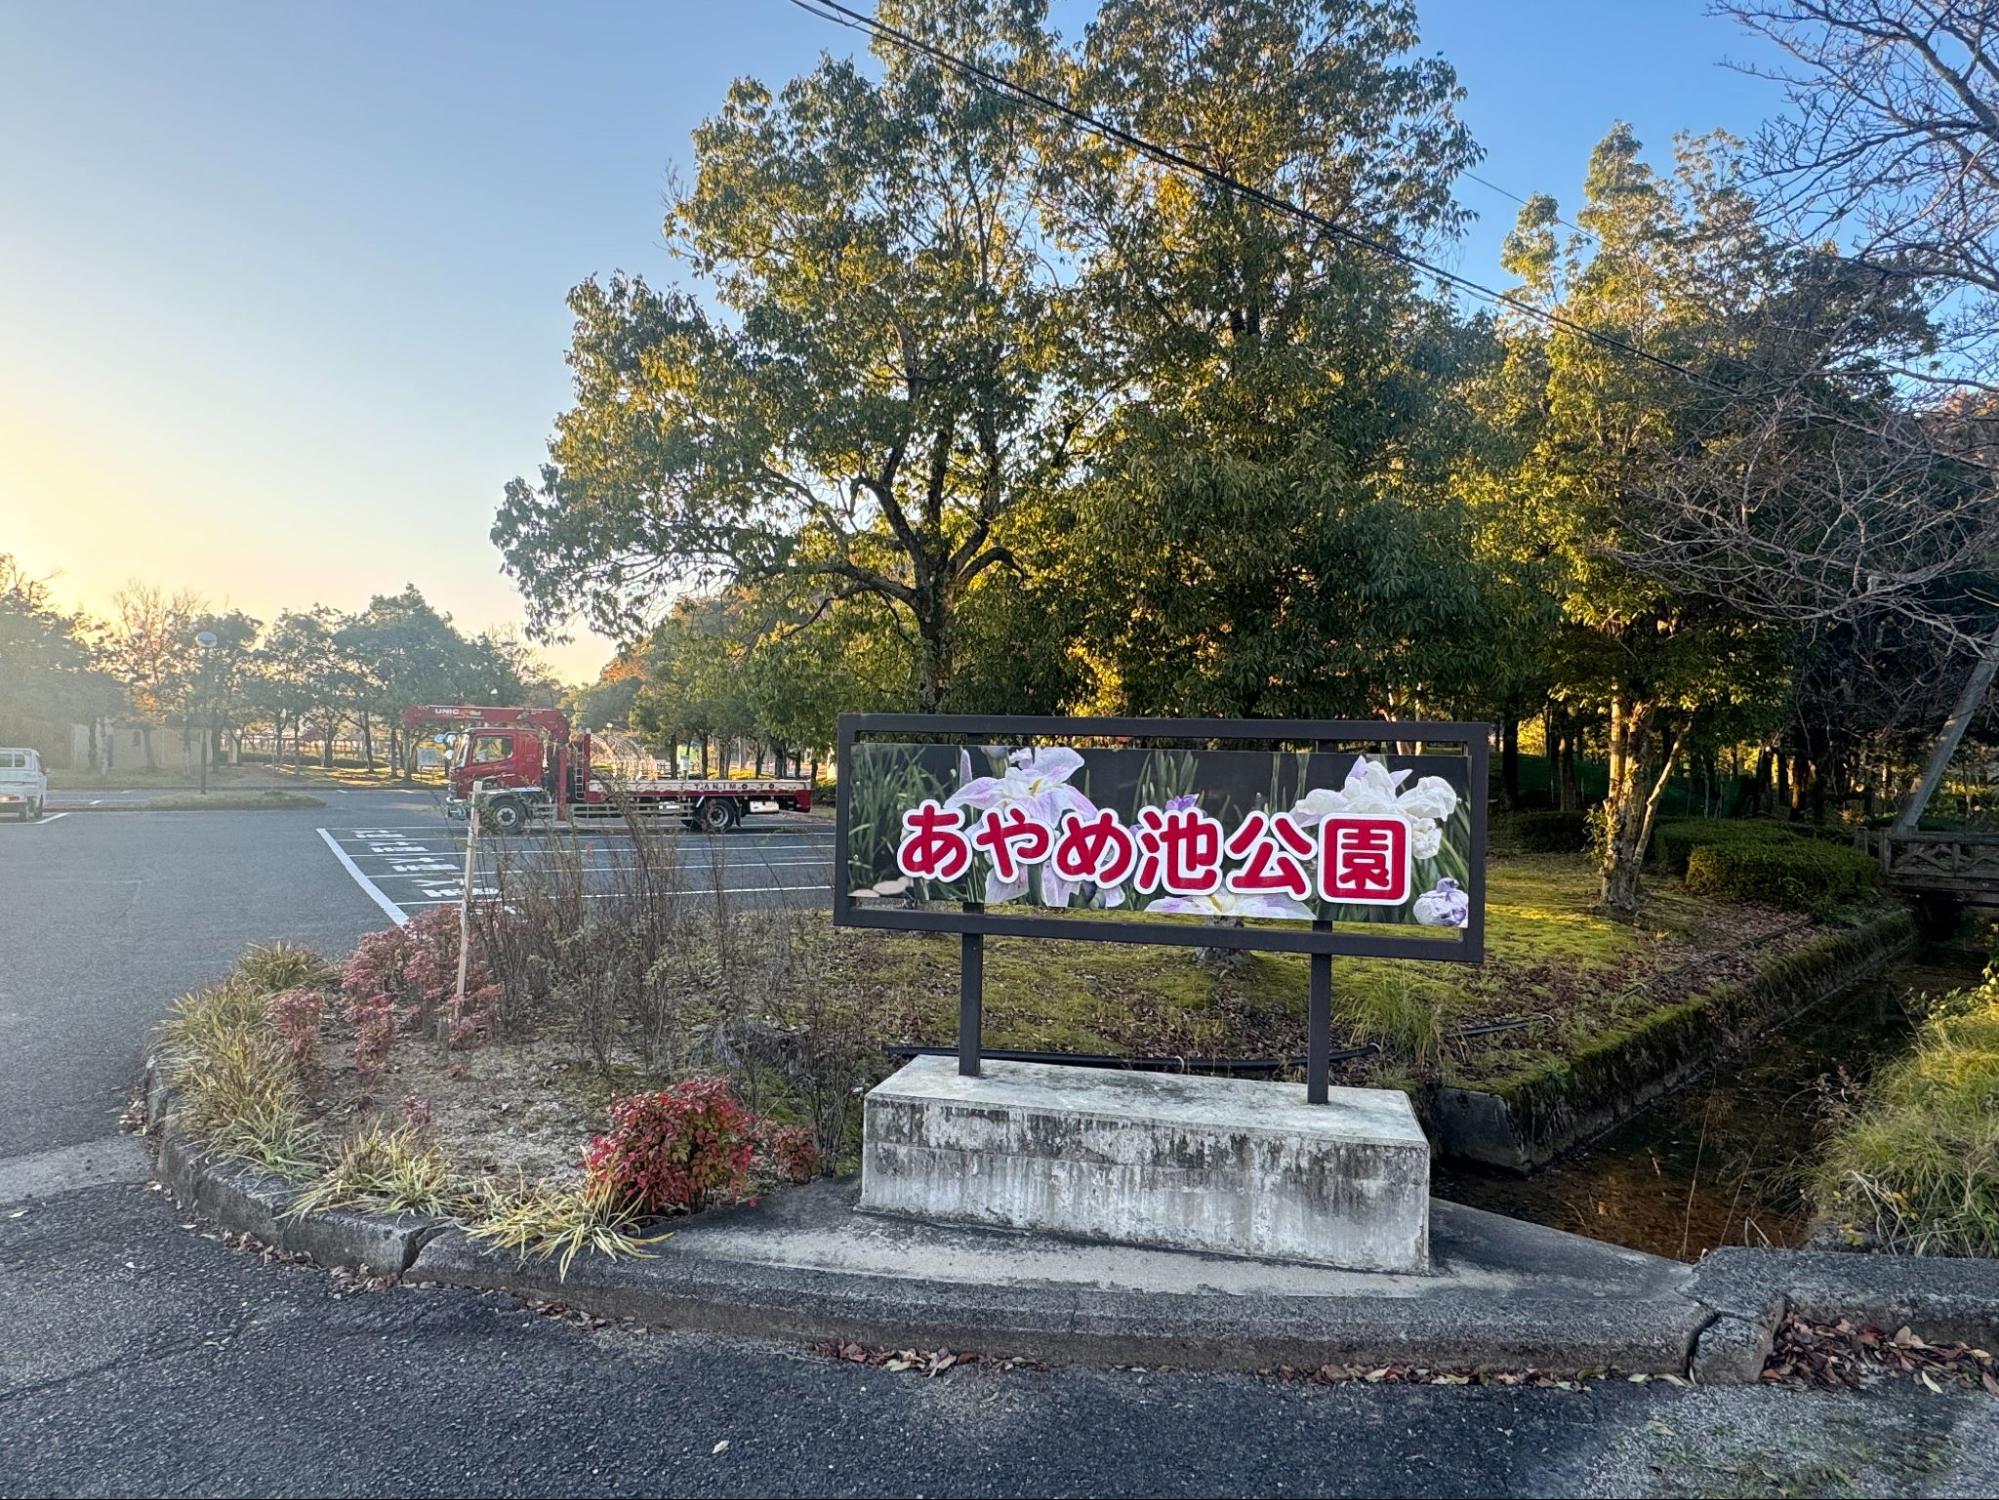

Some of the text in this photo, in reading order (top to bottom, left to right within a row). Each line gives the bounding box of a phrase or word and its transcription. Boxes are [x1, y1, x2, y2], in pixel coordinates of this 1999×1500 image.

[434, 707, 460, 715] UNIC
[900, 801, 1410, 903] あやめ池公園
